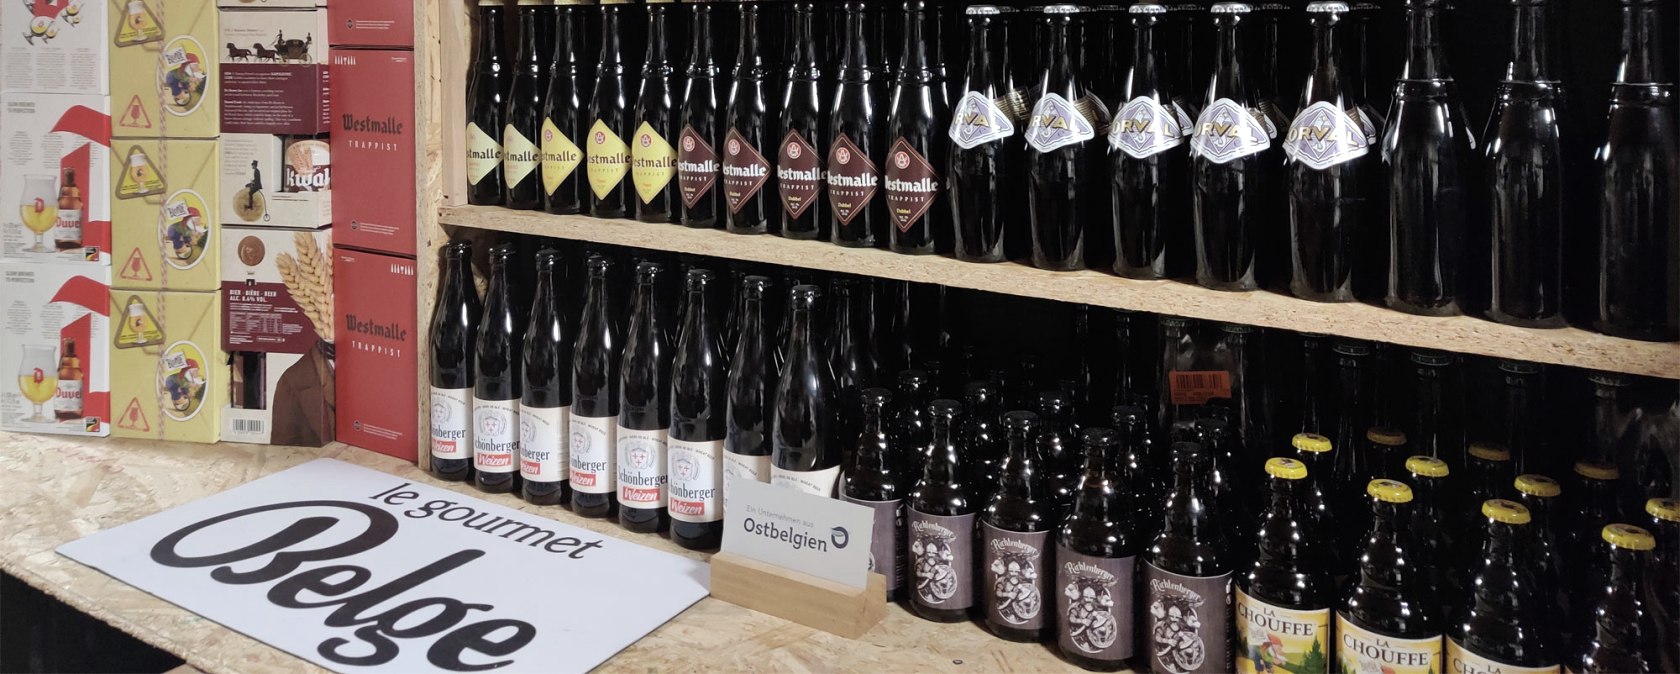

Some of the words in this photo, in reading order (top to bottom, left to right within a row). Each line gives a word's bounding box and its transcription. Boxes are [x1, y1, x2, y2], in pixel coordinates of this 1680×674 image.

[342, 114, 404, 134] Westmalle
[348, 140, 398, 151] TRAPPIST
[1288, 126, 1359, 148] ORVAL
[633, 157, 677, 168] estmalle
[723, 162, 766, 177] estmalle
[345, 314, 407, 342] Westmalle
[352, 340, 401, 358] TRAPPIST
[478, 453, 508, 466] Weizen
[624, 487, 657, 501] Weizen
[671, 498, 702, 514] Weizen
[368, 482, 419, 505] le
[404, 499, 604, 560] gourmet
[746, 504, 756, 514] Ein
[758, 506, 801, 526] Unternehmen
[802, 520, 814, 528] aus
[743, 517, 828, 552] Ostbelgien
[150, 500, 537, 672] Belge
[1237, 602, 1314, 636] CHOUFFE
[1263, 607, 1275, 617] LA
[1343, 633, 1429, 666] CHOUFFE
[1376, 638, 1390, 648] LA
